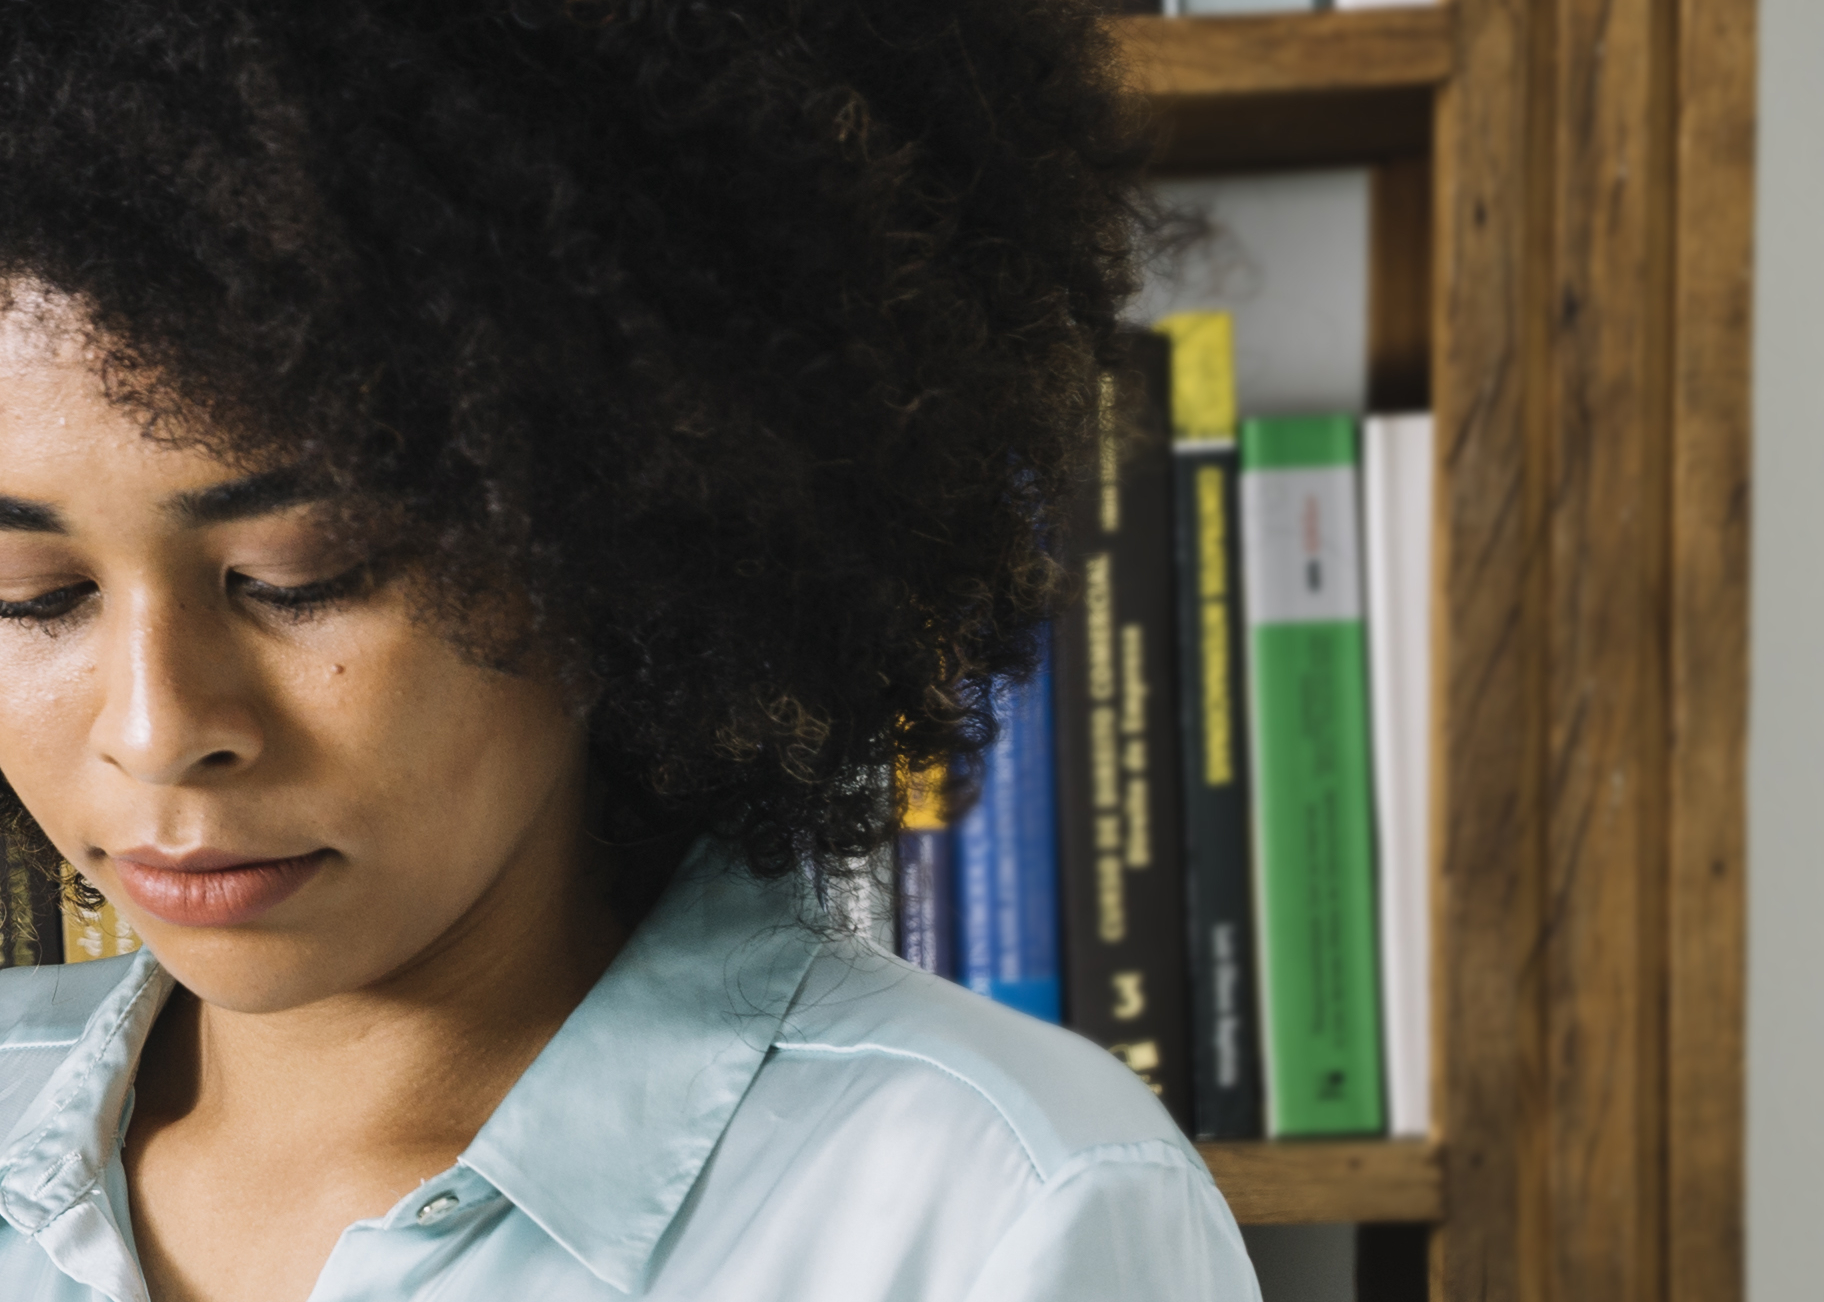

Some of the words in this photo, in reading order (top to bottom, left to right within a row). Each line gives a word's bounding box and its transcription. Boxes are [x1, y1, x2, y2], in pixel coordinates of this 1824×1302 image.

[1085, 554, 1115, 700] COMERCIAL
[1119, 625, 1149, 732] Empresa
[1091, 709, 1119, 806] DIREITO
[1122, 738, 1146, 771] de
[1094, 815, 1120, 848] DE
[1123, 781, 1149, 867] Direito
[1096, 857, 1125, 941] CURSO
